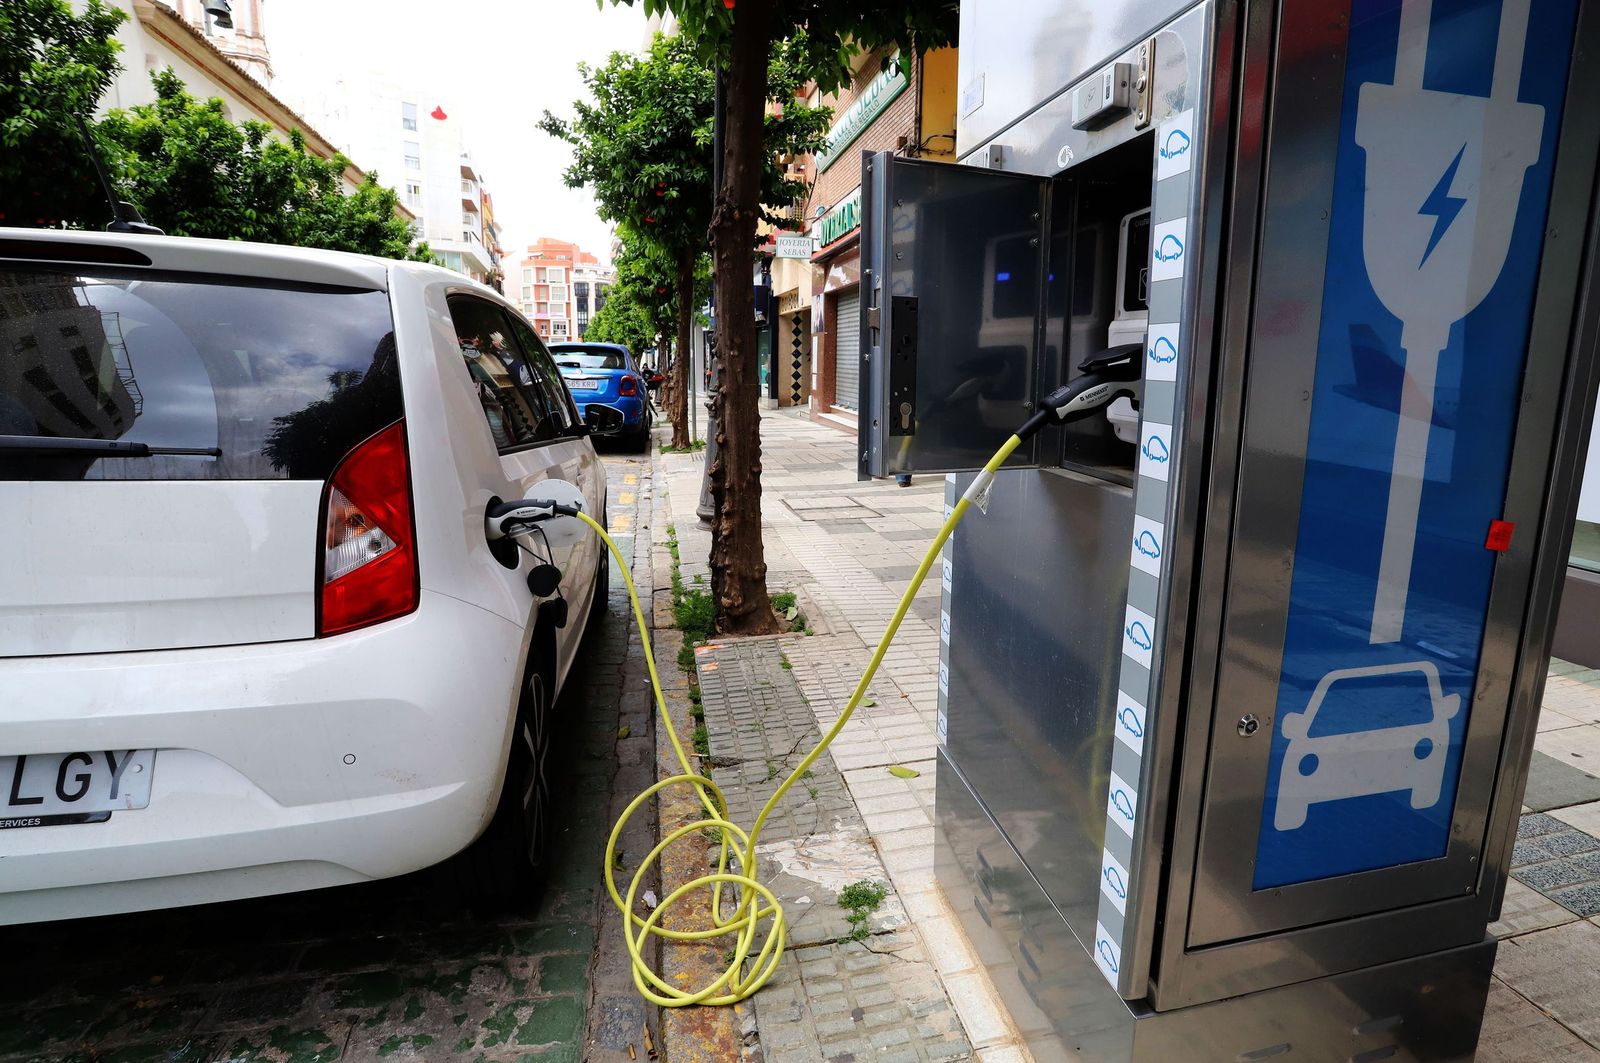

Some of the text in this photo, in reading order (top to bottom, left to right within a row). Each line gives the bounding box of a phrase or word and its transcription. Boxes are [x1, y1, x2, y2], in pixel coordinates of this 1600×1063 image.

[858, 100, 880, 124] REGALO
[819, 202, 852, 247] OYERIA
[778, 238, 811, 248] JOYERIA
[783, 248, 807, 257] SEBAS
[566, 380, 581, 388] 565
[8, 749, 137, 806] LGY
[0, 817, 41, 828] ERVICES
